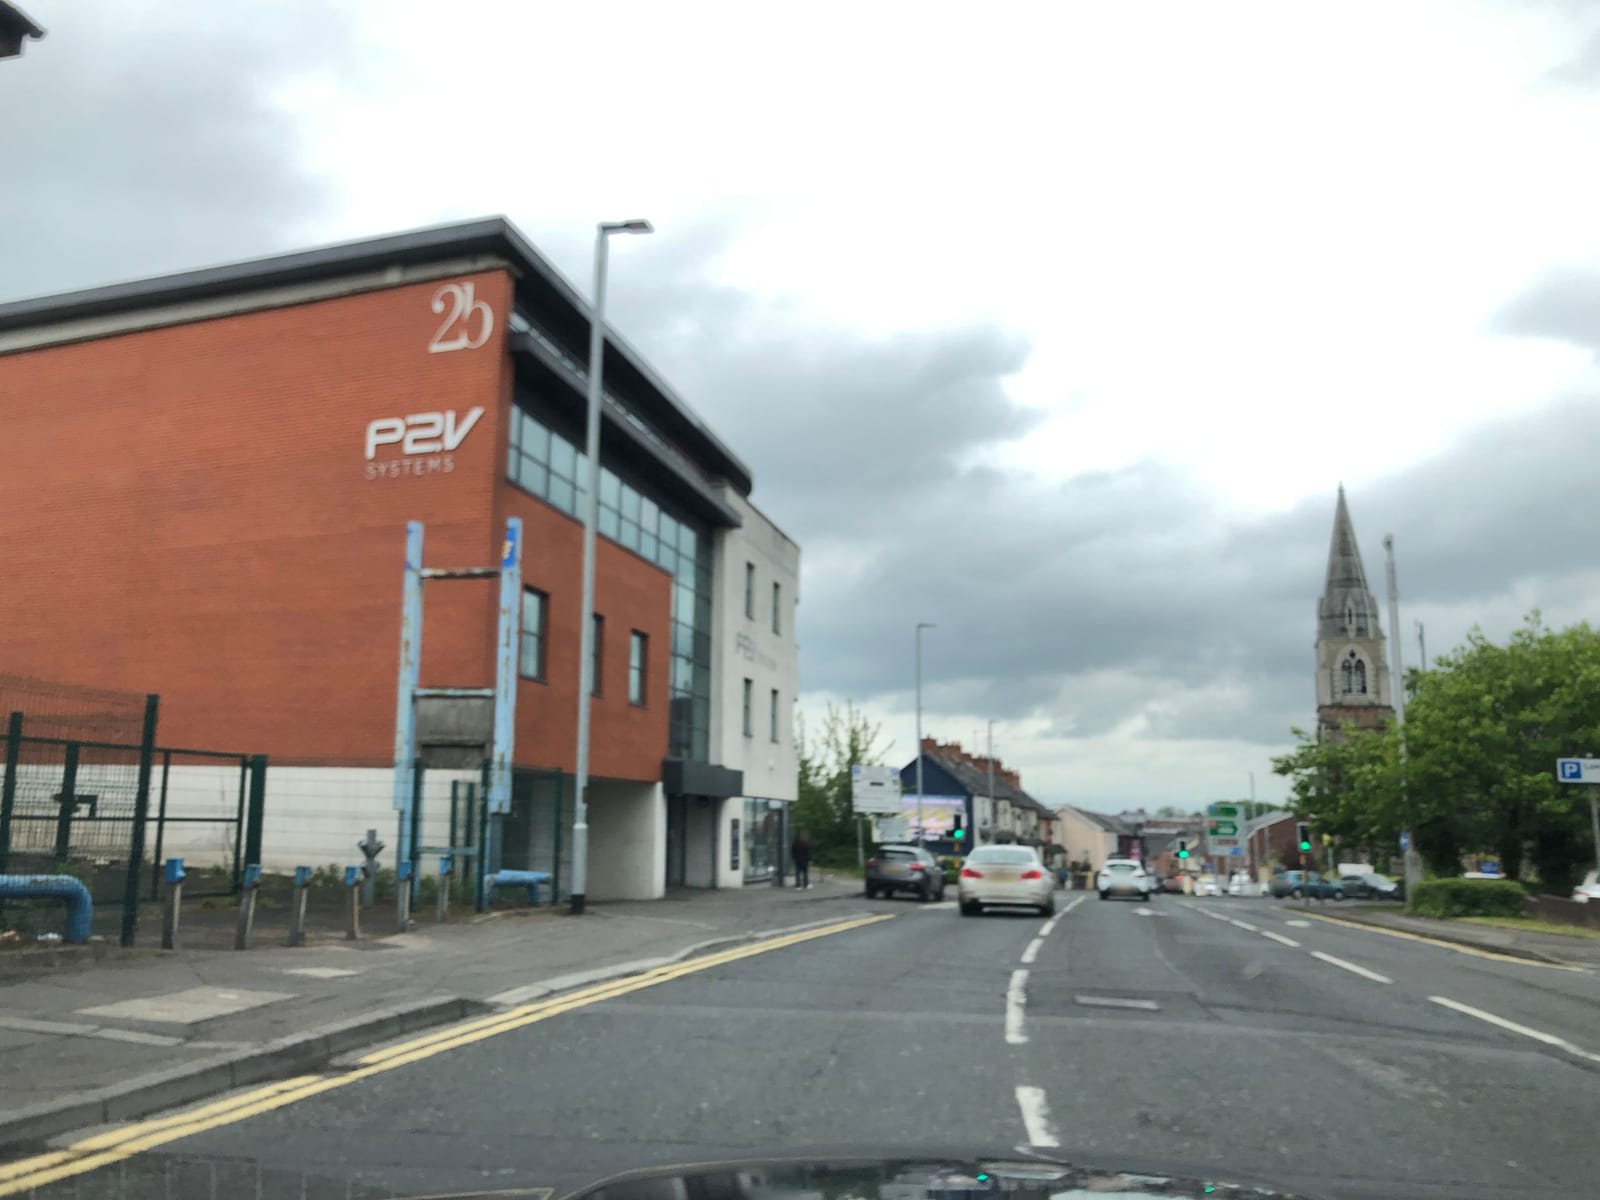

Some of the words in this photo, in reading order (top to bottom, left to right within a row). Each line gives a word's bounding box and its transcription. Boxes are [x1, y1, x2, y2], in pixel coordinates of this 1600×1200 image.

[365, 406, 485, 460] P2V
[366, 456, 455, 479] SYSTEMS
[1564, 763, 1578, 777] P
